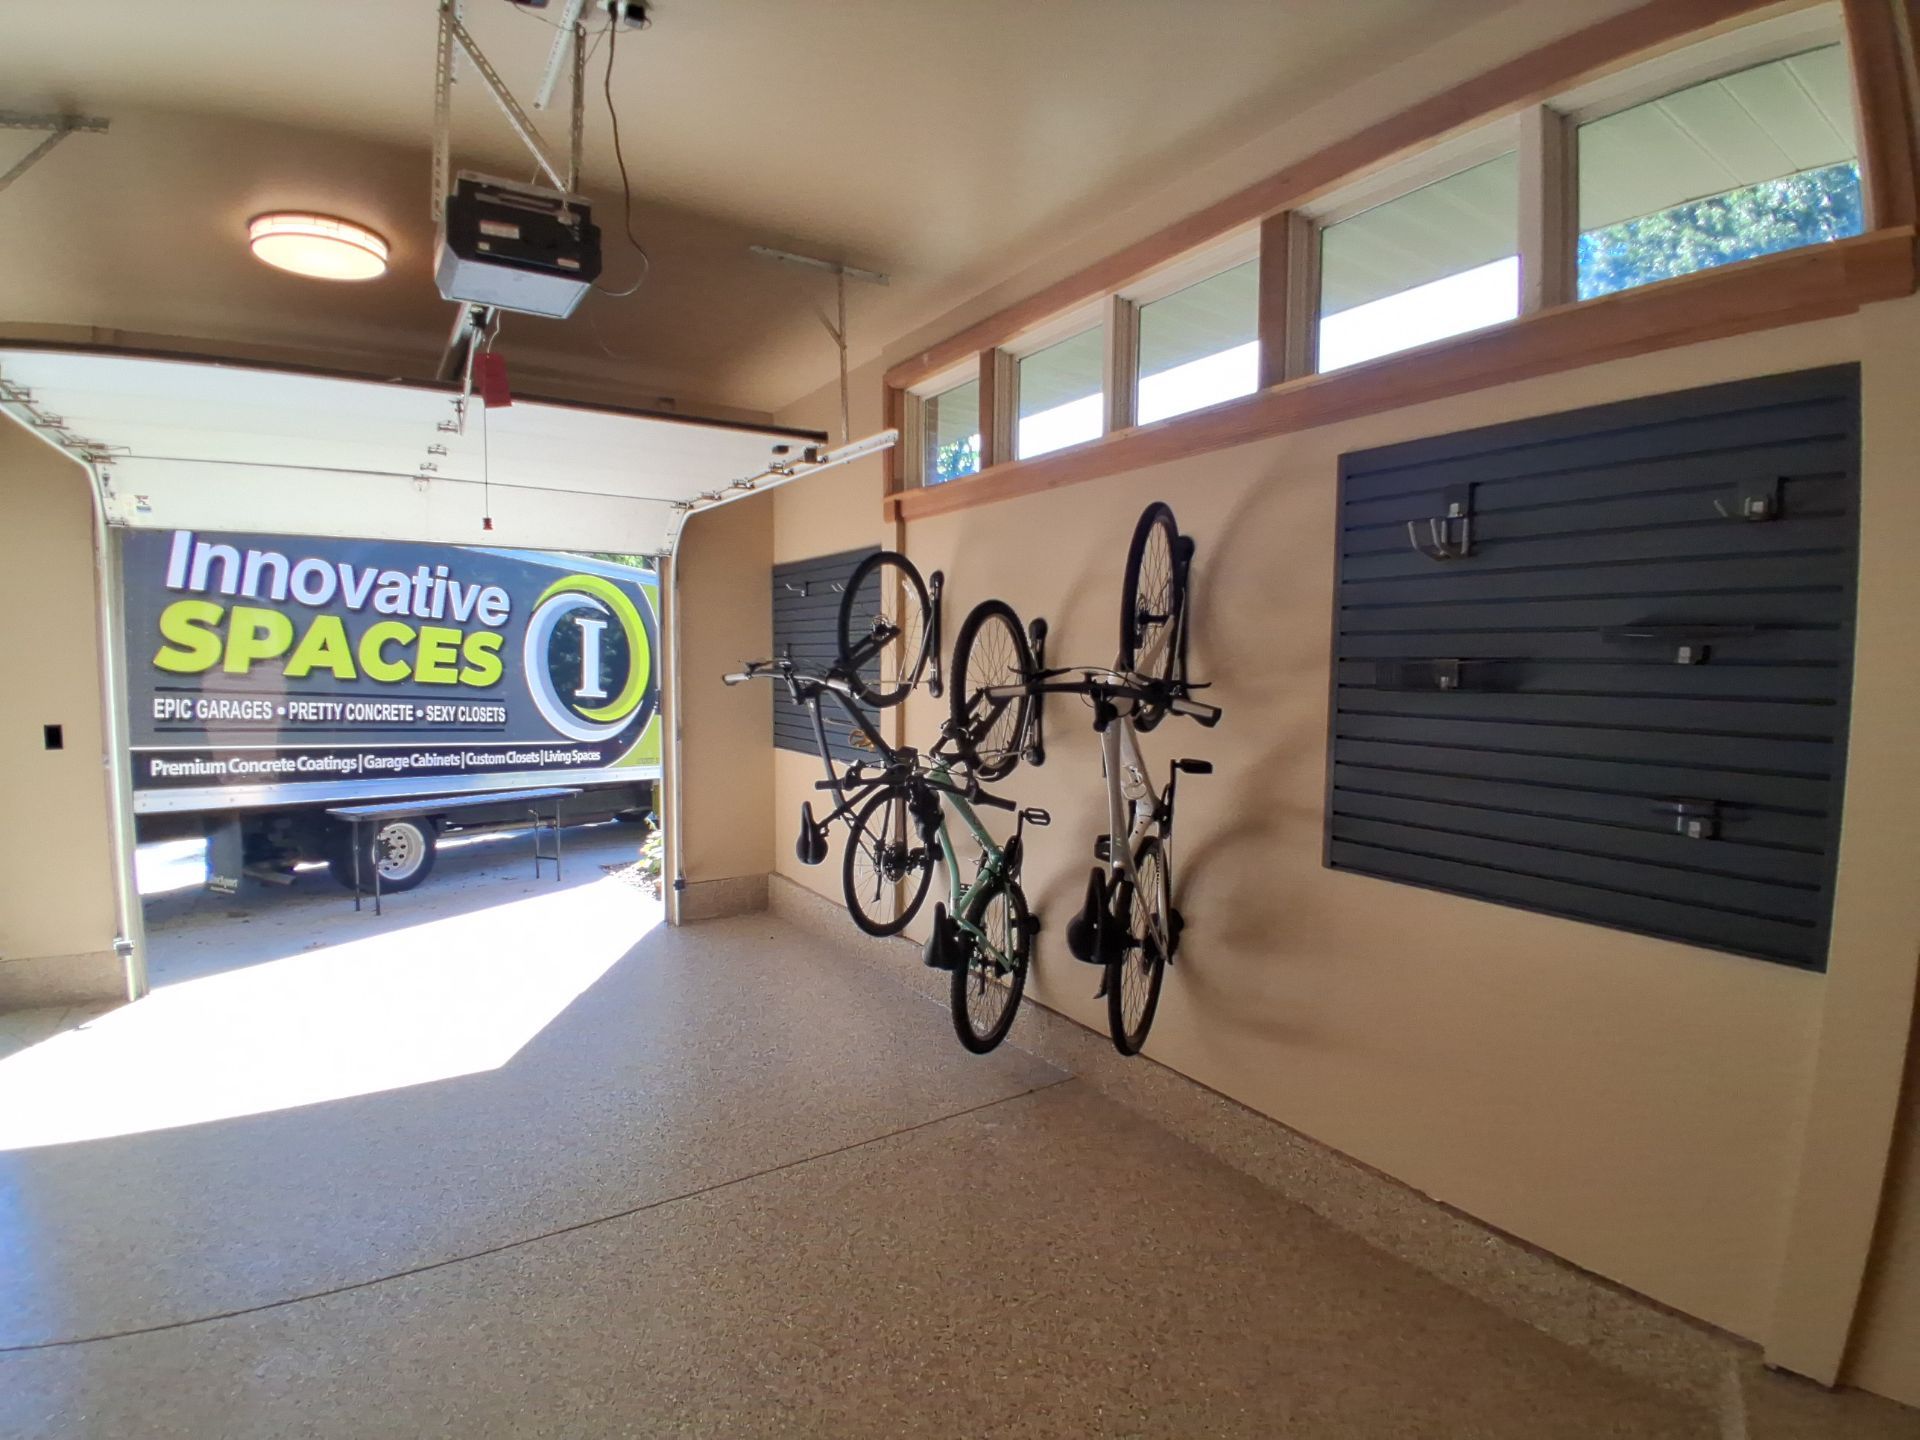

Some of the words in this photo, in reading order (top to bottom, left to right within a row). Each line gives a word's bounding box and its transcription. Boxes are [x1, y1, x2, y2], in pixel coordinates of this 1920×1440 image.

[166, 530, 511, 627] Innovative
[152, 600, 505, 687] SPACES
[154, 698, 192, 719] EPIC
[196, 700, 272, 719] GARAGES
[289, 702, 342, 720] PRETTY
[346, 703, 413, 721] CONCRETE
[426, 705, 455, 722] SEXY
[458, 706, 506, 723] CLOSETS
[151, 758, 226, 776] Premium
[228, 758, 295, 773] Concrete
[297, 755, 357, 773] Coatings
[364, 755, 409, 771] Garage
[410, 752, 460, 768] Cabinets
[466, 752, 505, 765] Custom
[506, 751, 540, 764] Closets
[545, 750, 571, 765] Living
[572, 750, 600, 764] Spaces
